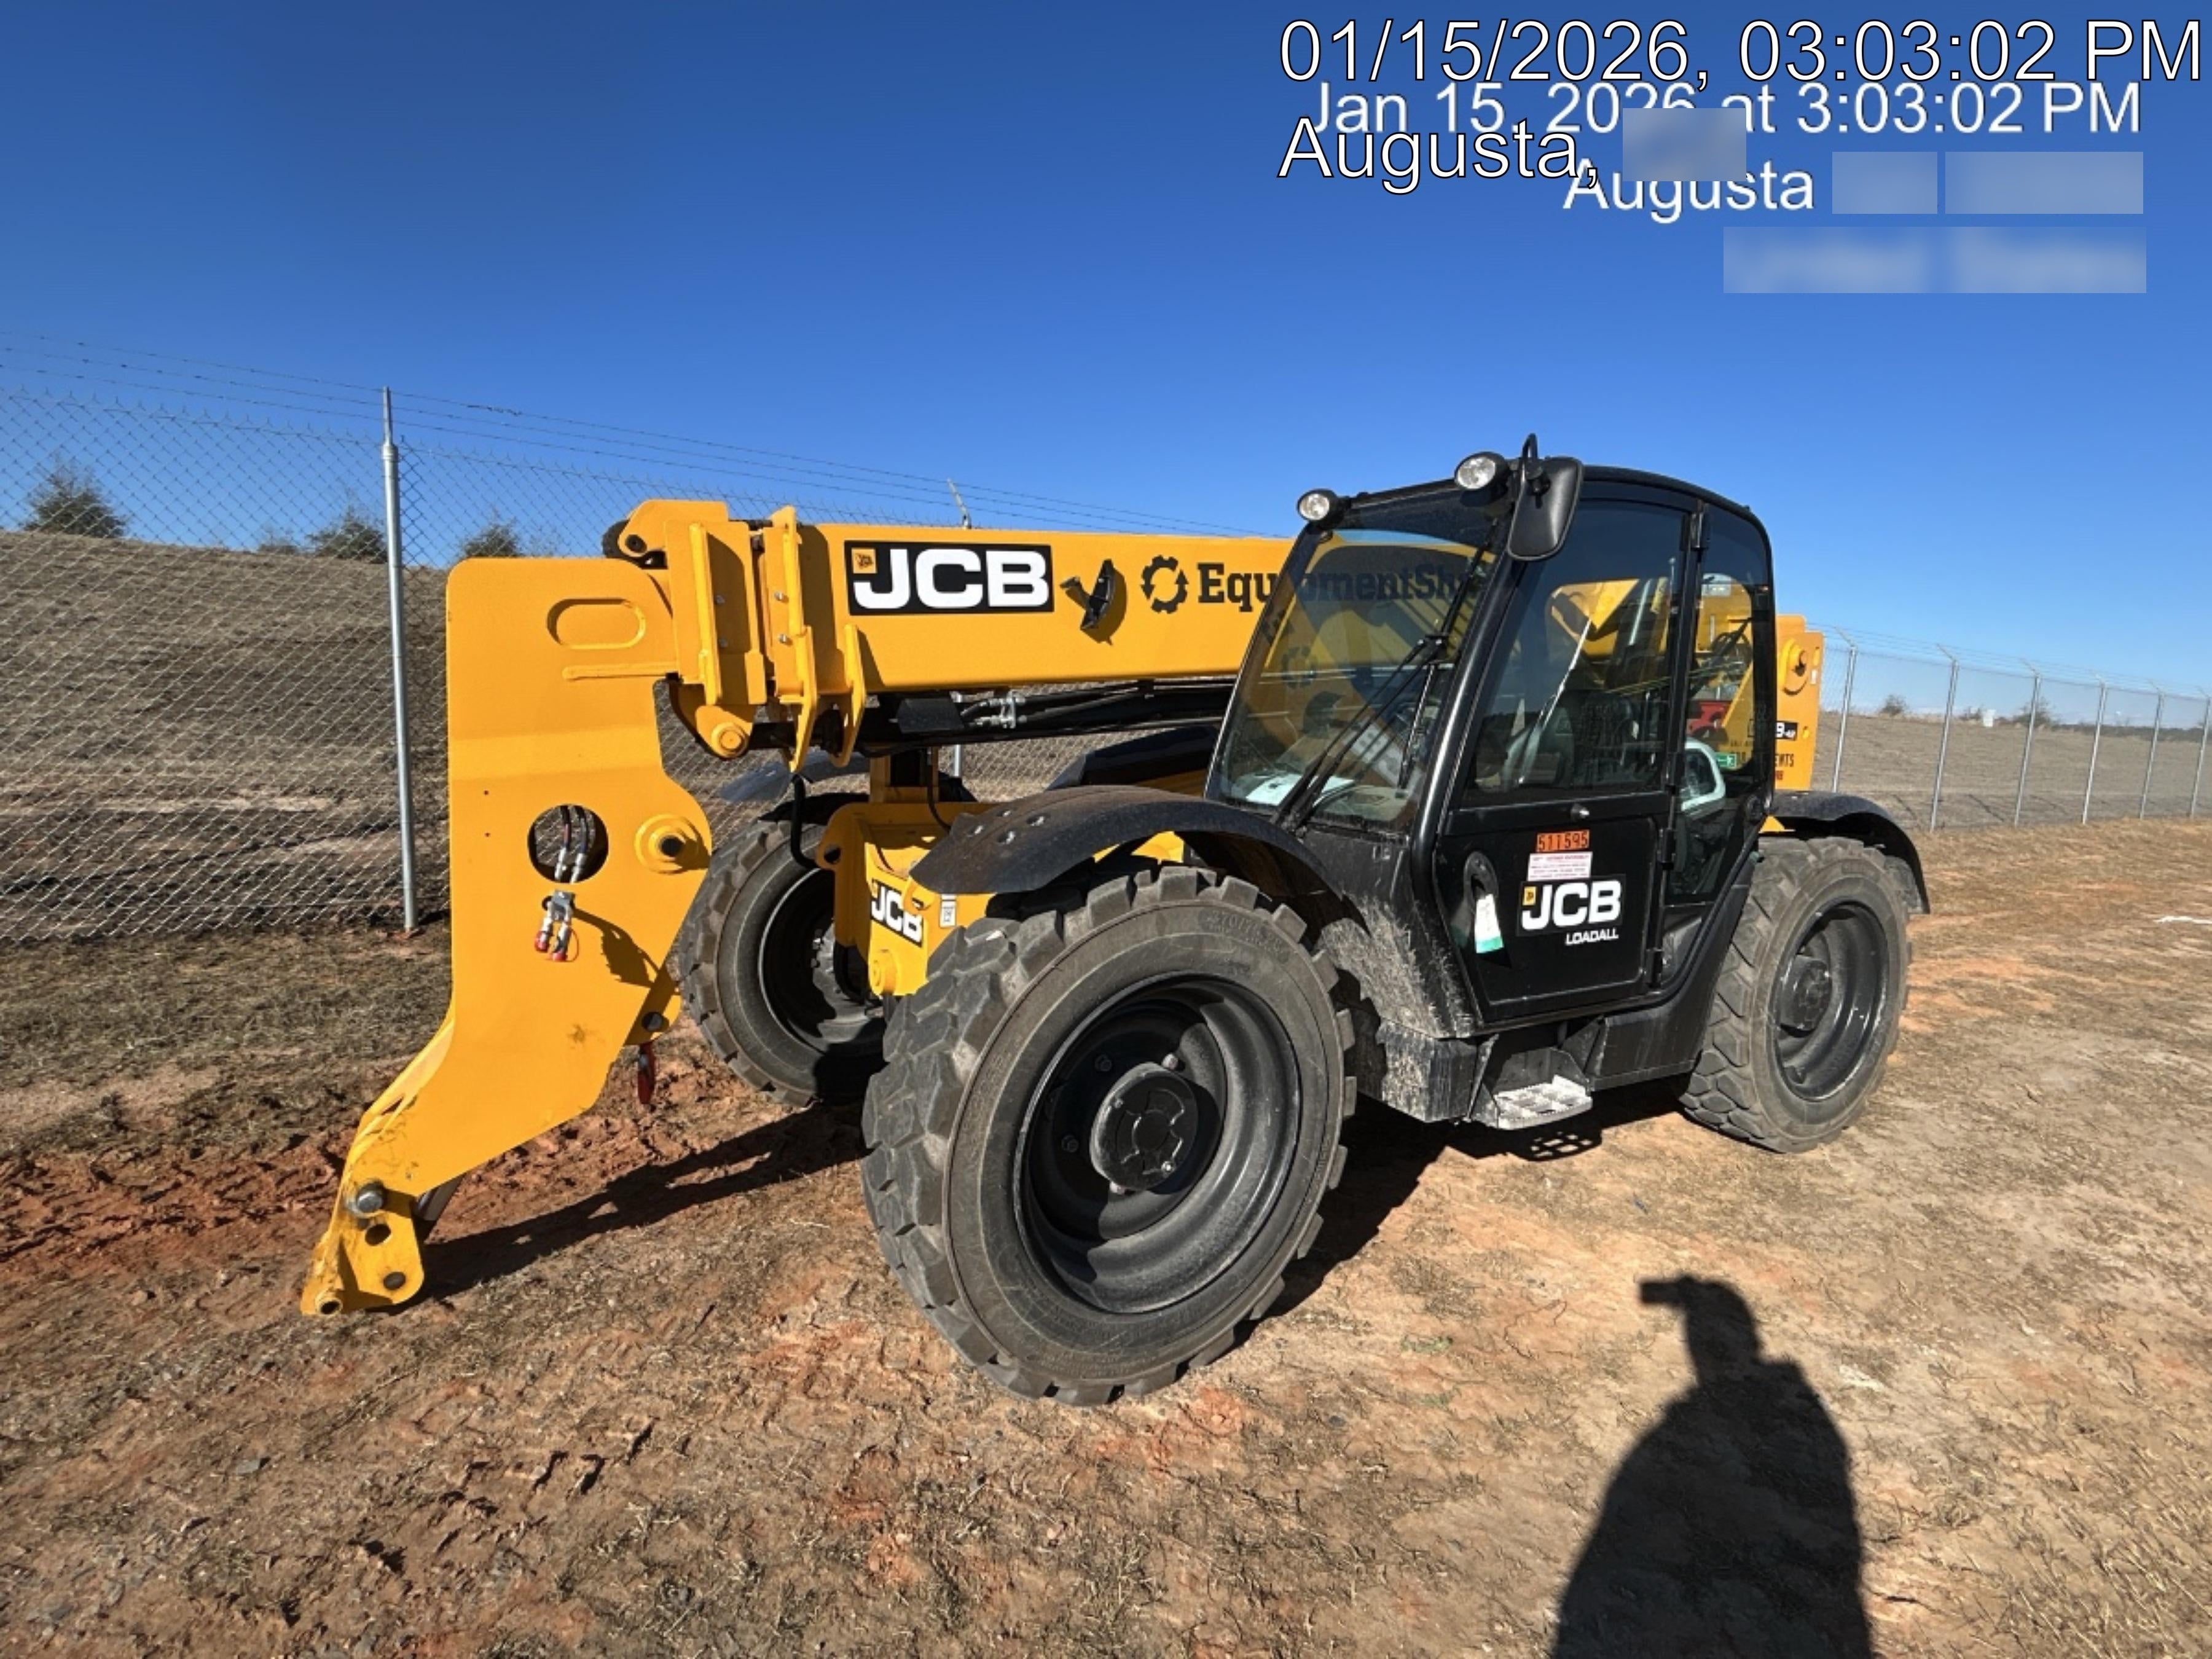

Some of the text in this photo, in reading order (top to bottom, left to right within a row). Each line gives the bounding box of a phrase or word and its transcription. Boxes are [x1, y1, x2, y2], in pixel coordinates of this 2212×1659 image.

[853, 548, 1049, 610] JCB
[1538, 831, 1588, 851] 511595
[871, 886, 922, 943] JCB
[1522, 880, 1622, 930] JCB
[1566, 928, 1618, 945] LOADALL
